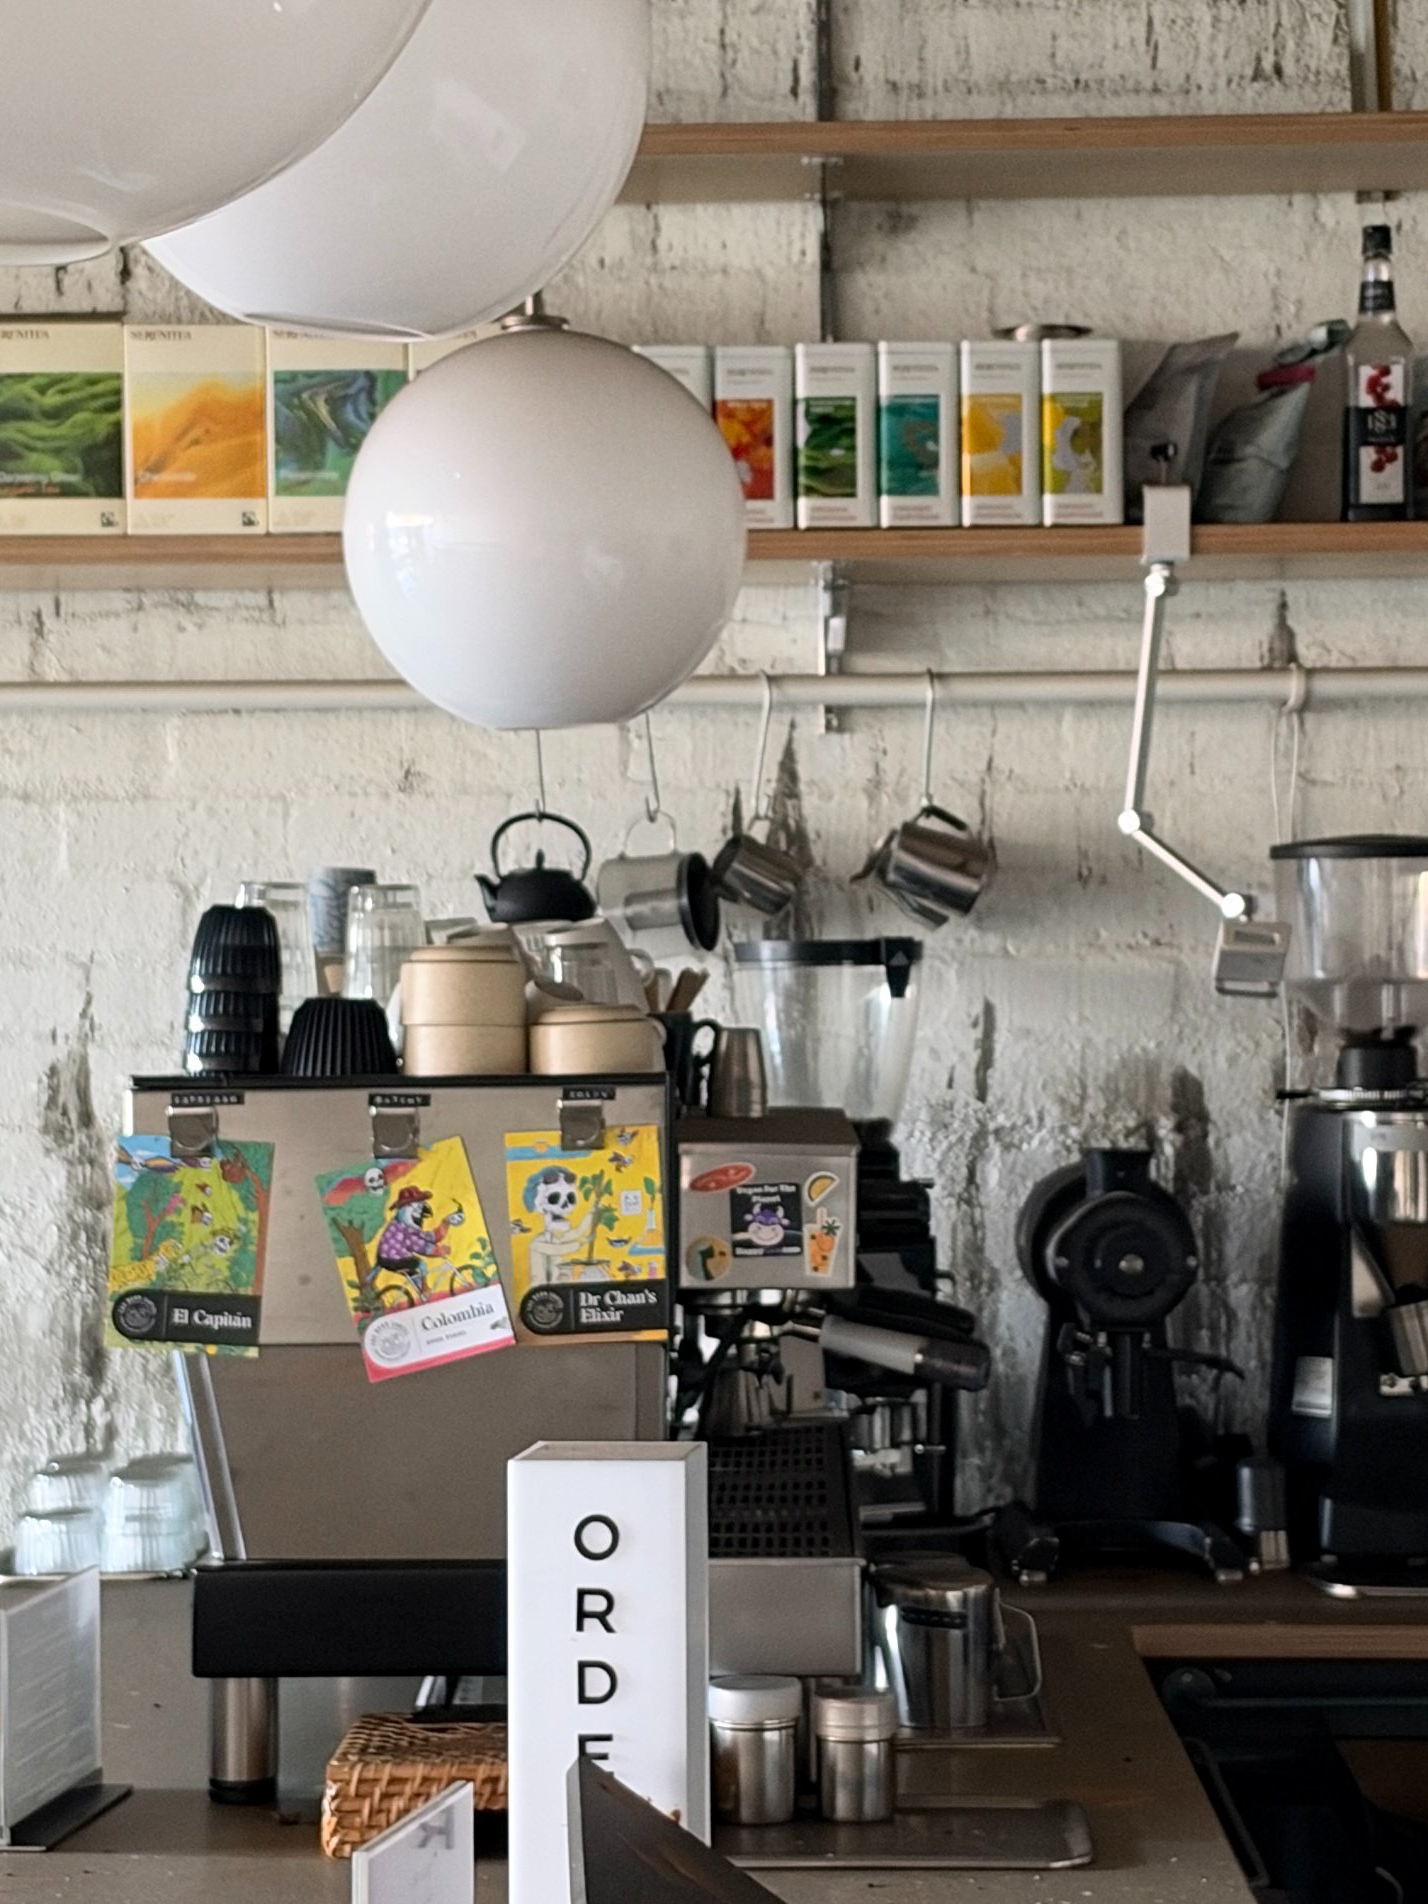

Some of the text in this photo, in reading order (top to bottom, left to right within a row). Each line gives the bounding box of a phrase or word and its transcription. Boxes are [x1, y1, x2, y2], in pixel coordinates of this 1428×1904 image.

[579, 1288, 657, 1306] Dr Chan's
[173, 1308, 189, 1324] El
[421, 1301, 494, 1331] Colombia
[580, 1306, 624, 1323] Elixir
[574, 1514, 620, 1778] ORDE
